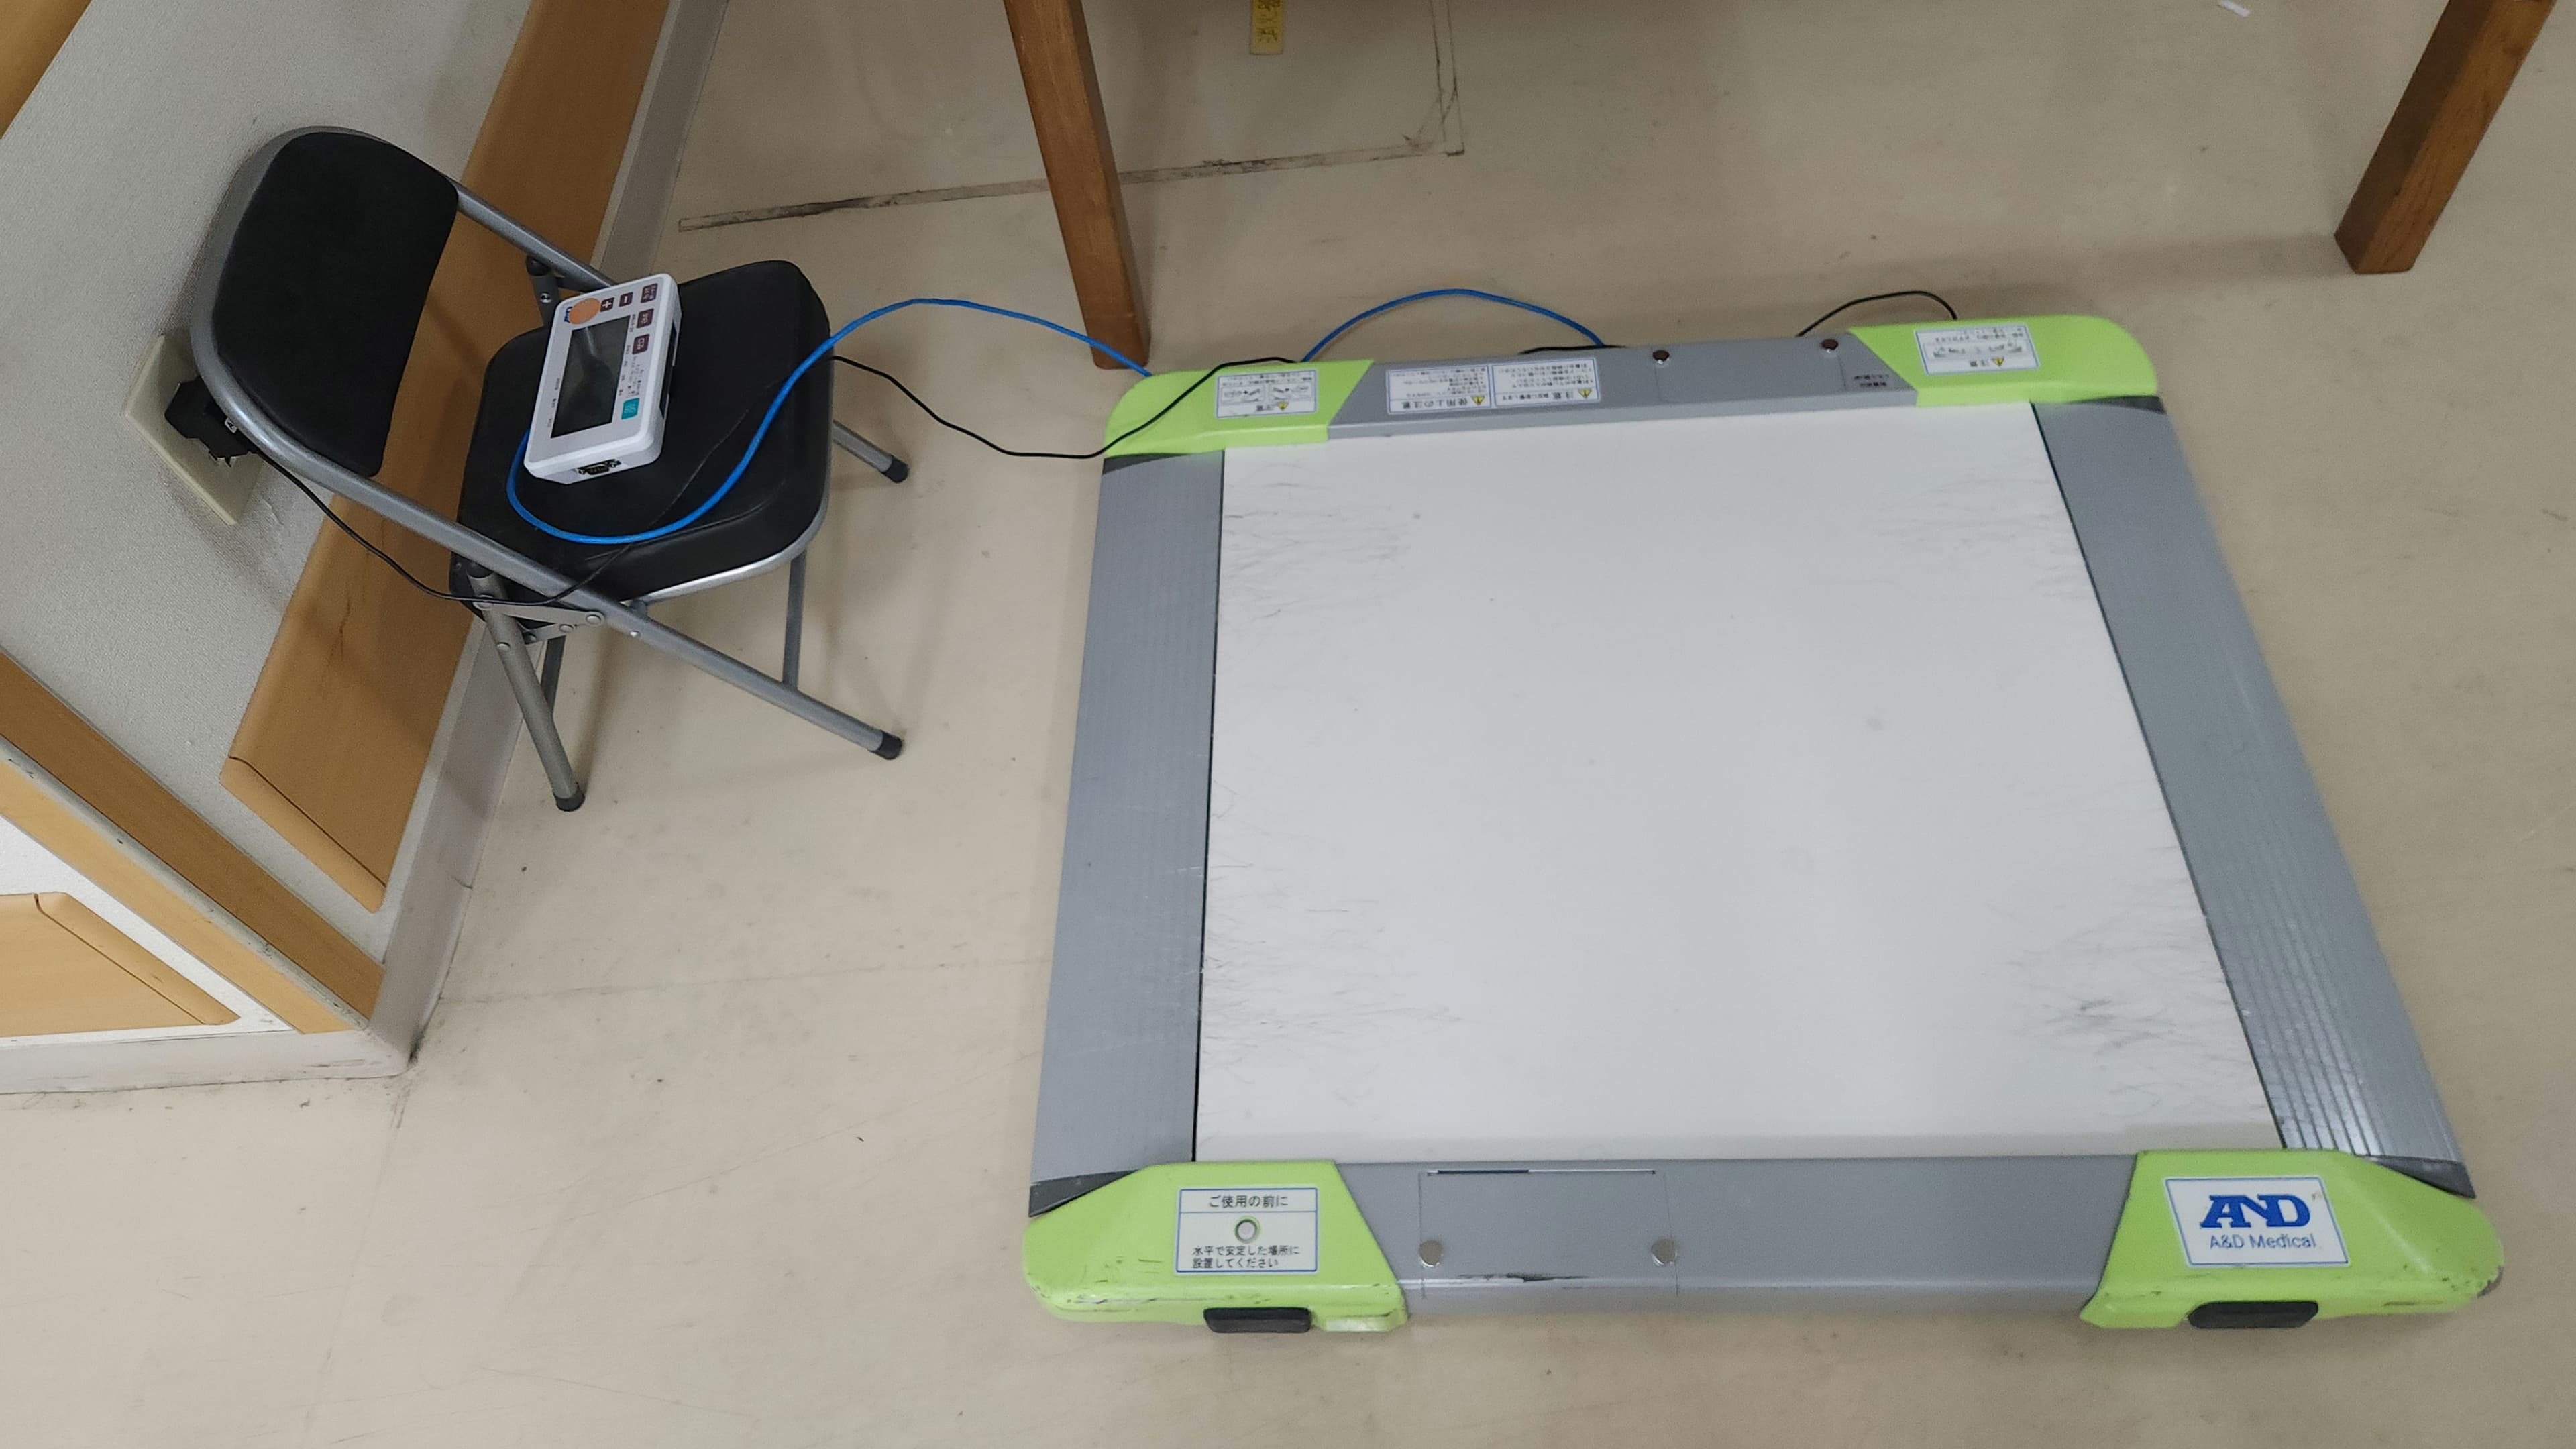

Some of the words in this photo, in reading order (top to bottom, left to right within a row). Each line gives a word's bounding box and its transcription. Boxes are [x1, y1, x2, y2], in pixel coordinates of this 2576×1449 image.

[1401, 398, 1468, 409] 使用上の注意
[1209, 1195, 1289, 1208] ご使用の前に
[2210, 1234, 2244, 1248] A&D
[2250, 1233, 2316, 1248] Medical
[1192, 1245, 1300, 1256] 水平で安定した場所に
[1192, 1258, 1279, 1269] 設置してください
